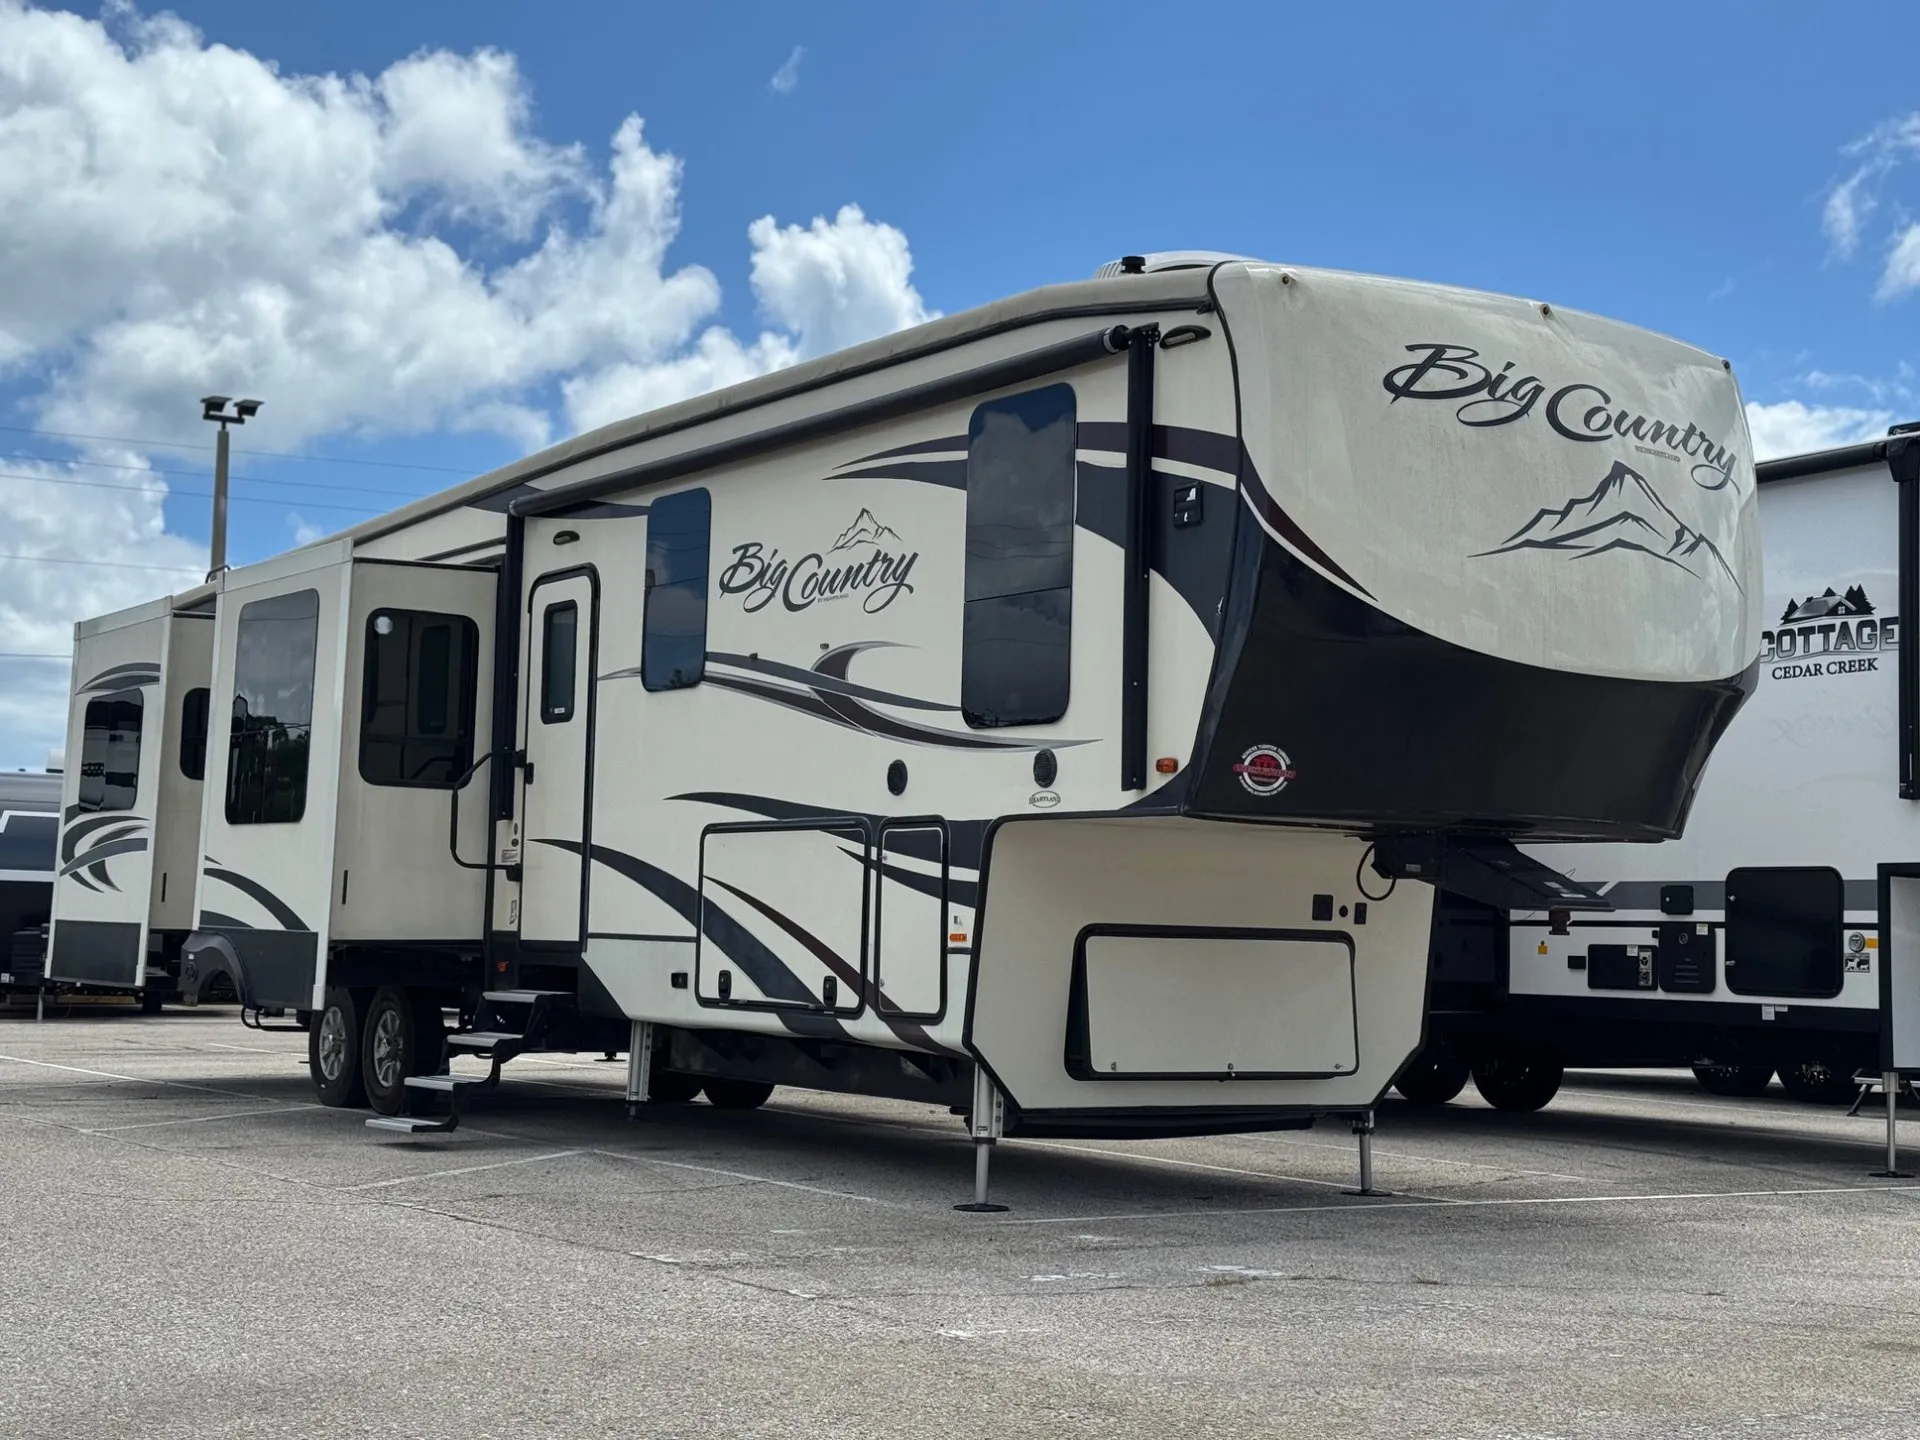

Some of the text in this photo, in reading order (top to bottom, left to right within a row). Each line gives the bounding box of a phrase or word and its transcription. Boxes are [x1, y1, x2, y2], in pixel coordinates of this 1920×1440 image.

[1383, 343, 1741, 495] Big Country
[719, 542, 919, 614] Big Country
[1760, 616, 1899, 664] COTTAGE
[1772, 658, 1879, 680] CEDAR CREEK
